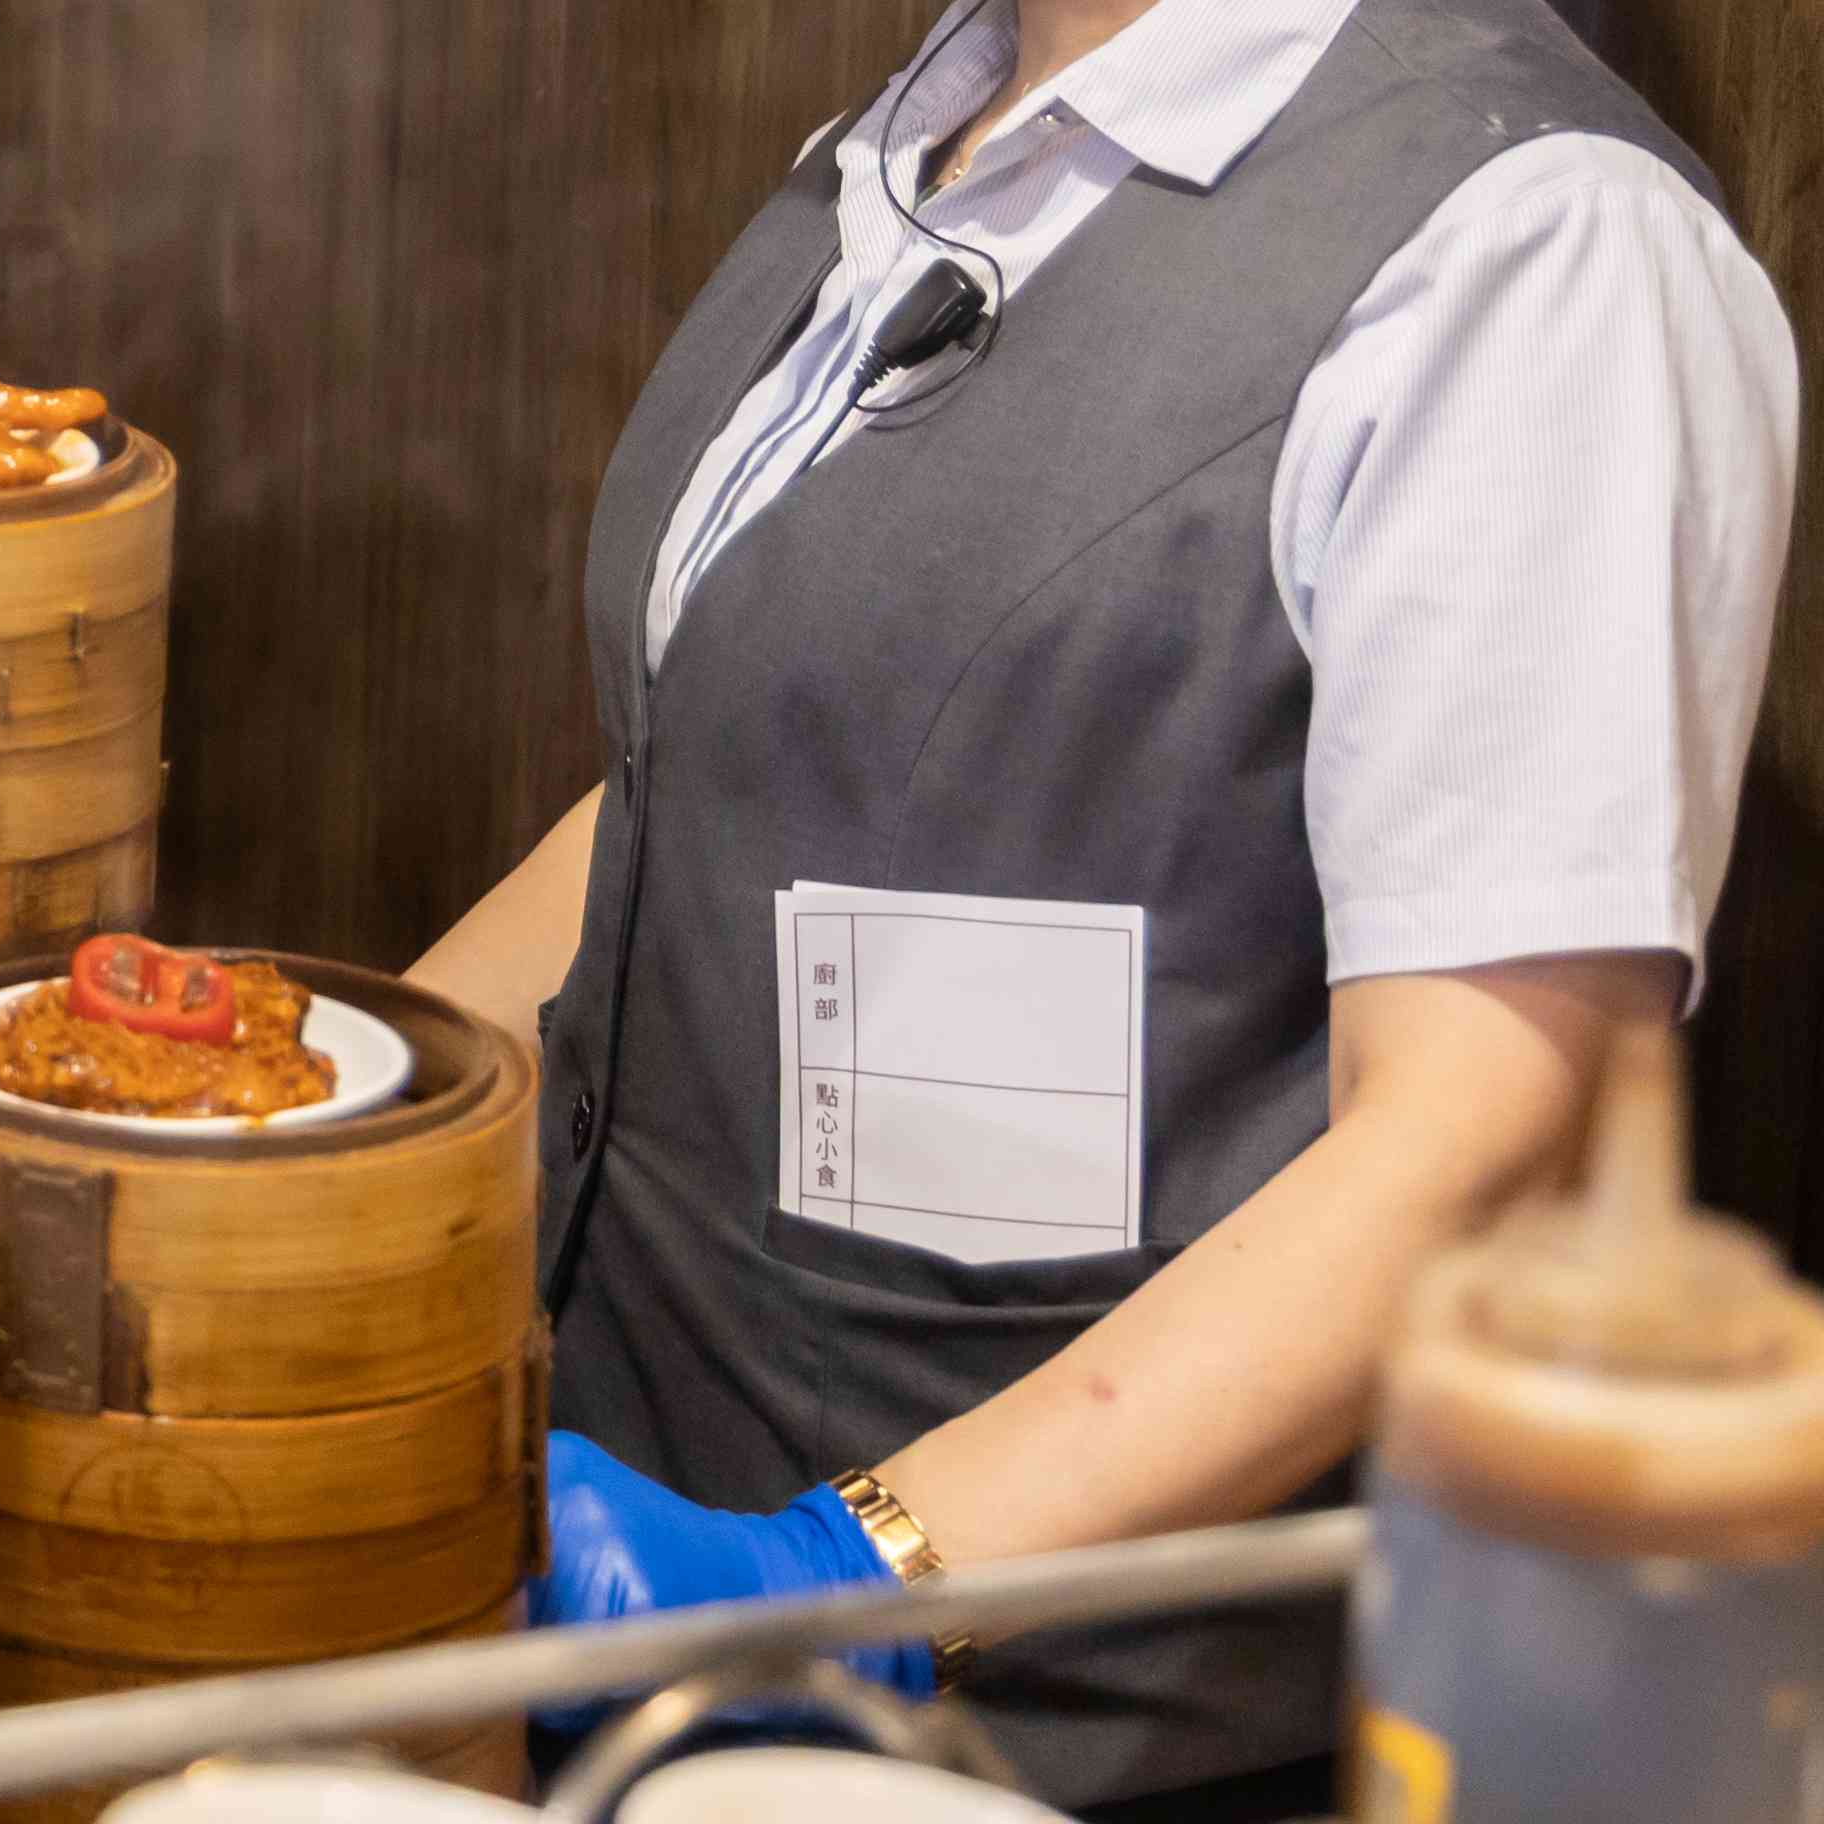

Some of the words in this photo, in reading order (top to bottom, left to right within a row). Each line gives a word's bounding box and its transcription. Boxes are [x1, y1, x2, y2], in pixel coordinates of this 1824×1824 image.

[813, 962, 839, 1022] 廚部
[815, 1082, 840, 1189] 點心小食
